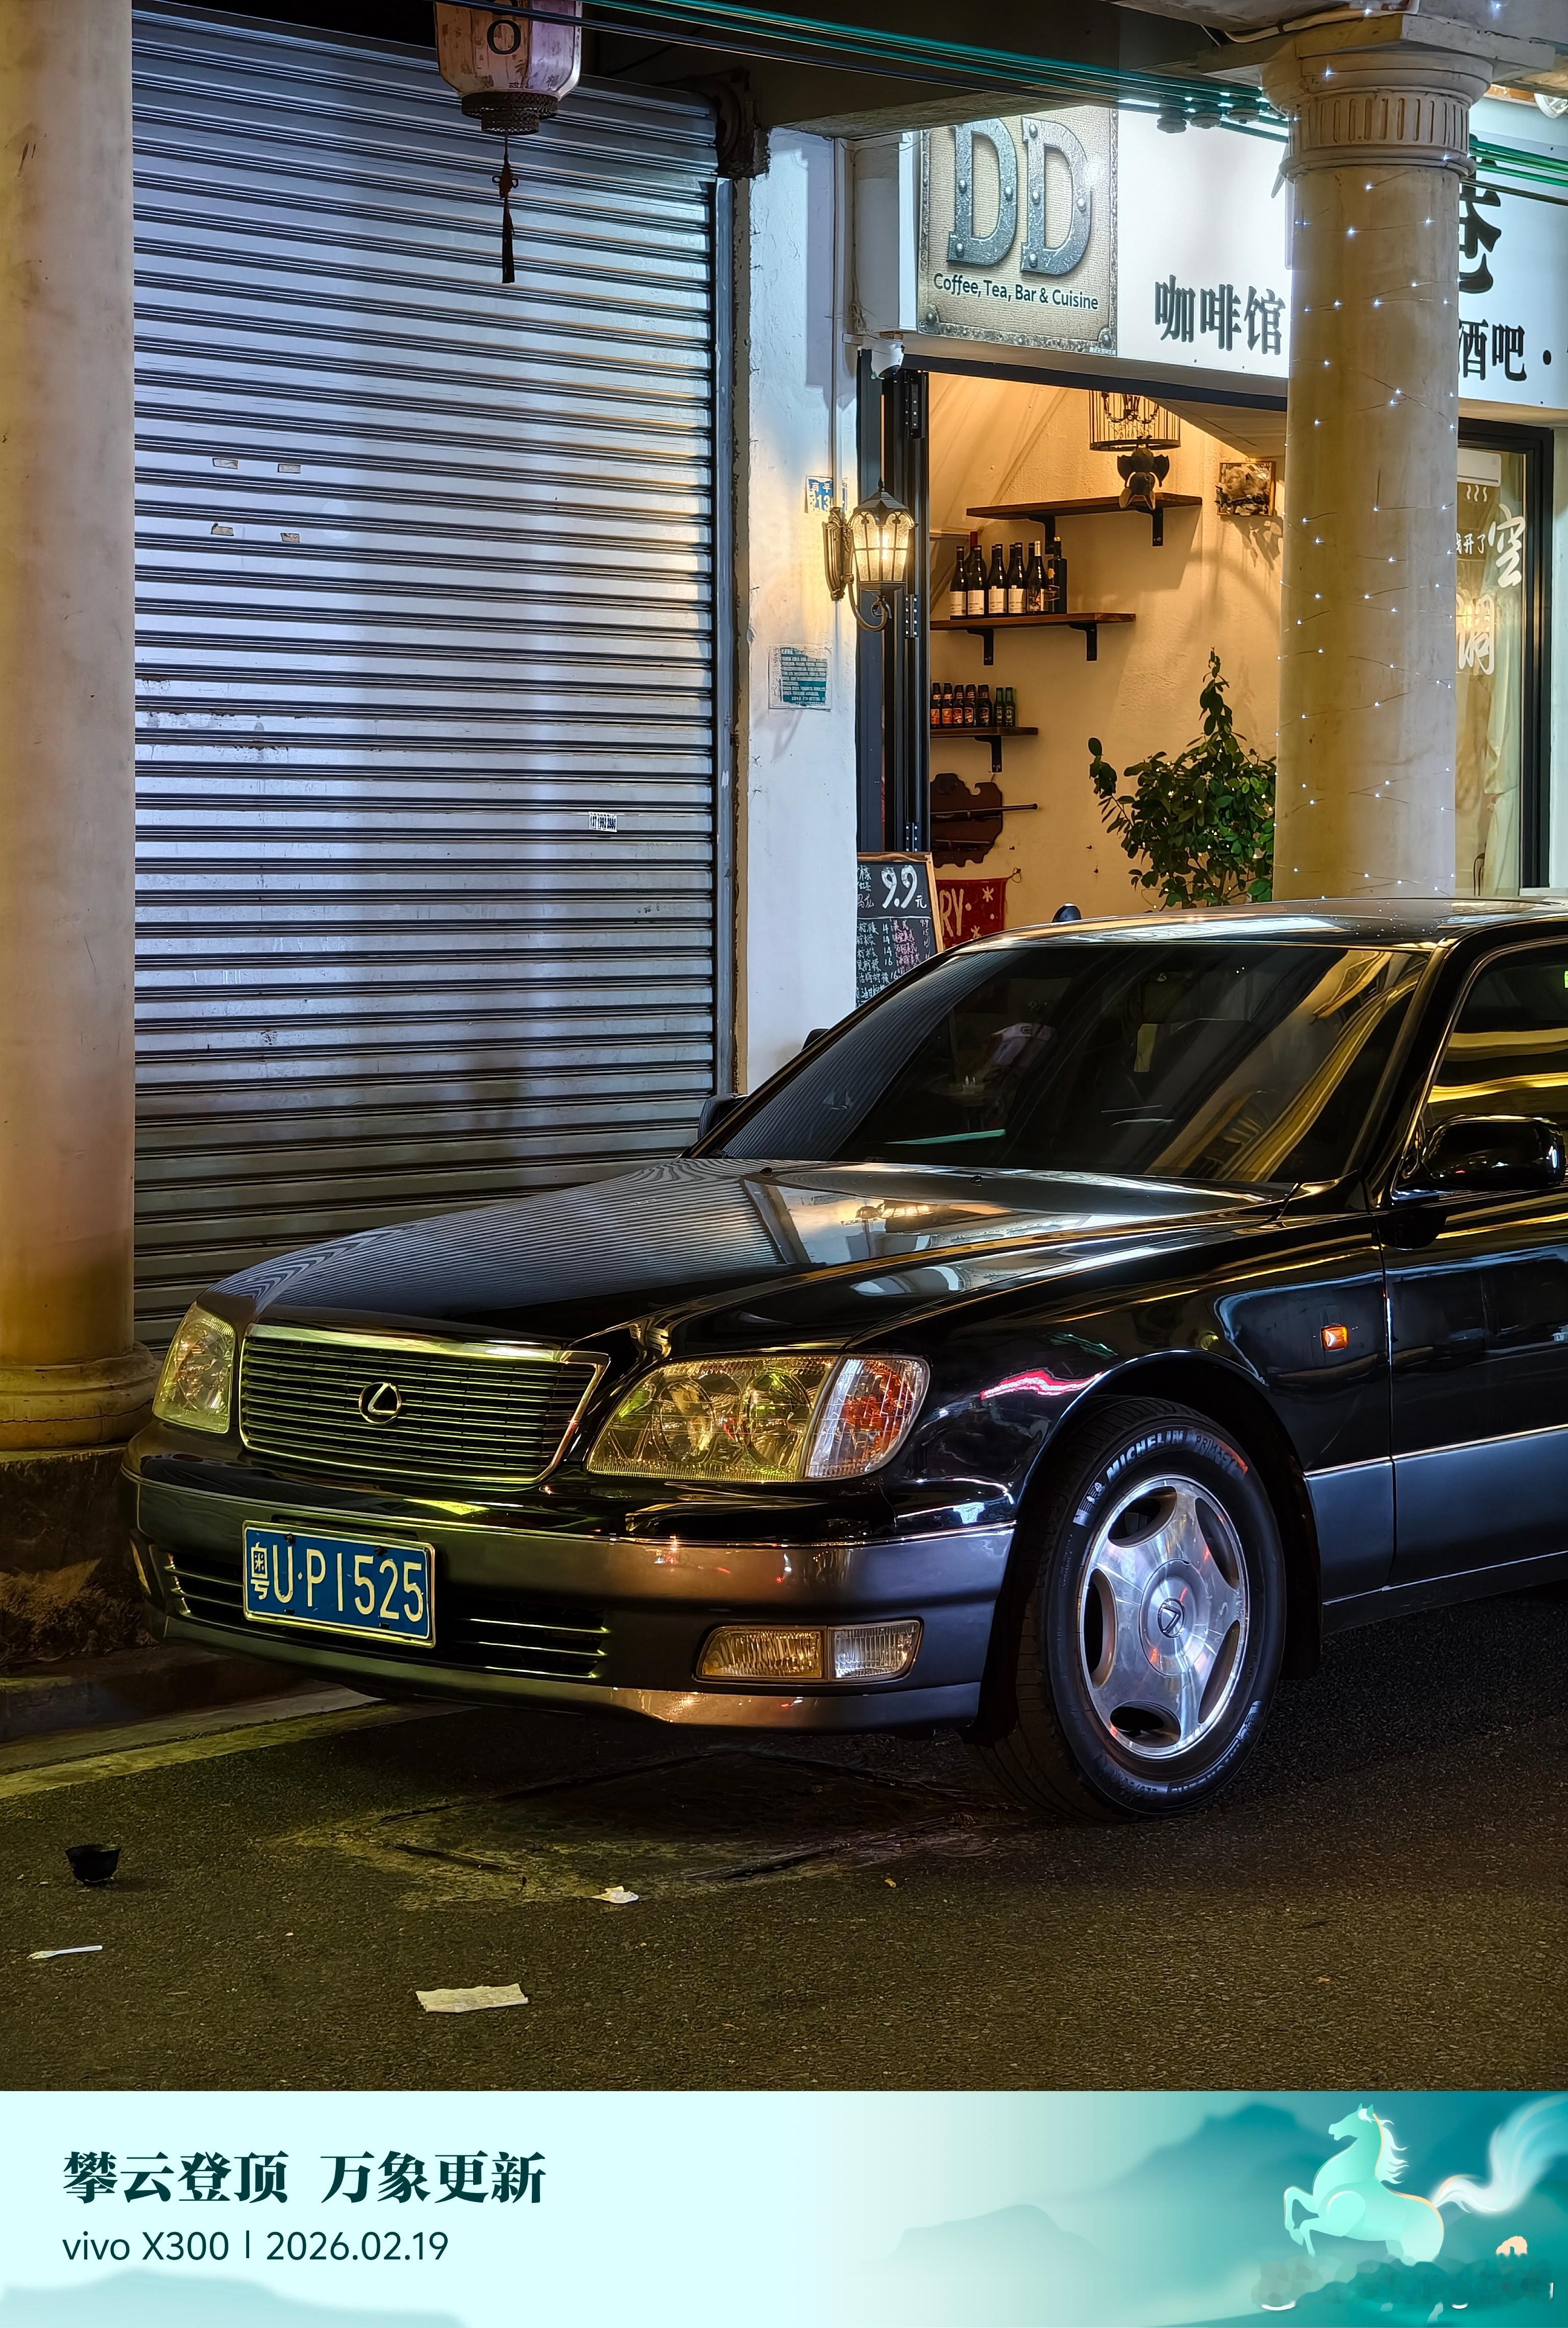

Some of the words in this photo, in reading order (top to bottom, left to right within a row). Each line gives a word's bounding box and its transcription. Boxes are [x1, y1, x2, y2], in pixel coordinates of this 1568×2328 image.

[946, 115, 1093, 276] DD
[934, 273, 982, 298] Coffee,
[983, 279, 1011, 302] Tea,
[1015, 284, 1037, 302] Bar
[1039, 287, 1048, 304] &
[1052, 289, 1098, 310] Cuisine
[1155, 275, 1286, 356] 咖啡馆
[1458, 318, 1527, 382] 酒吧
[885, 957, 893, 966] 16
[1106, 1429, 1184, 1484] MICHELIN
